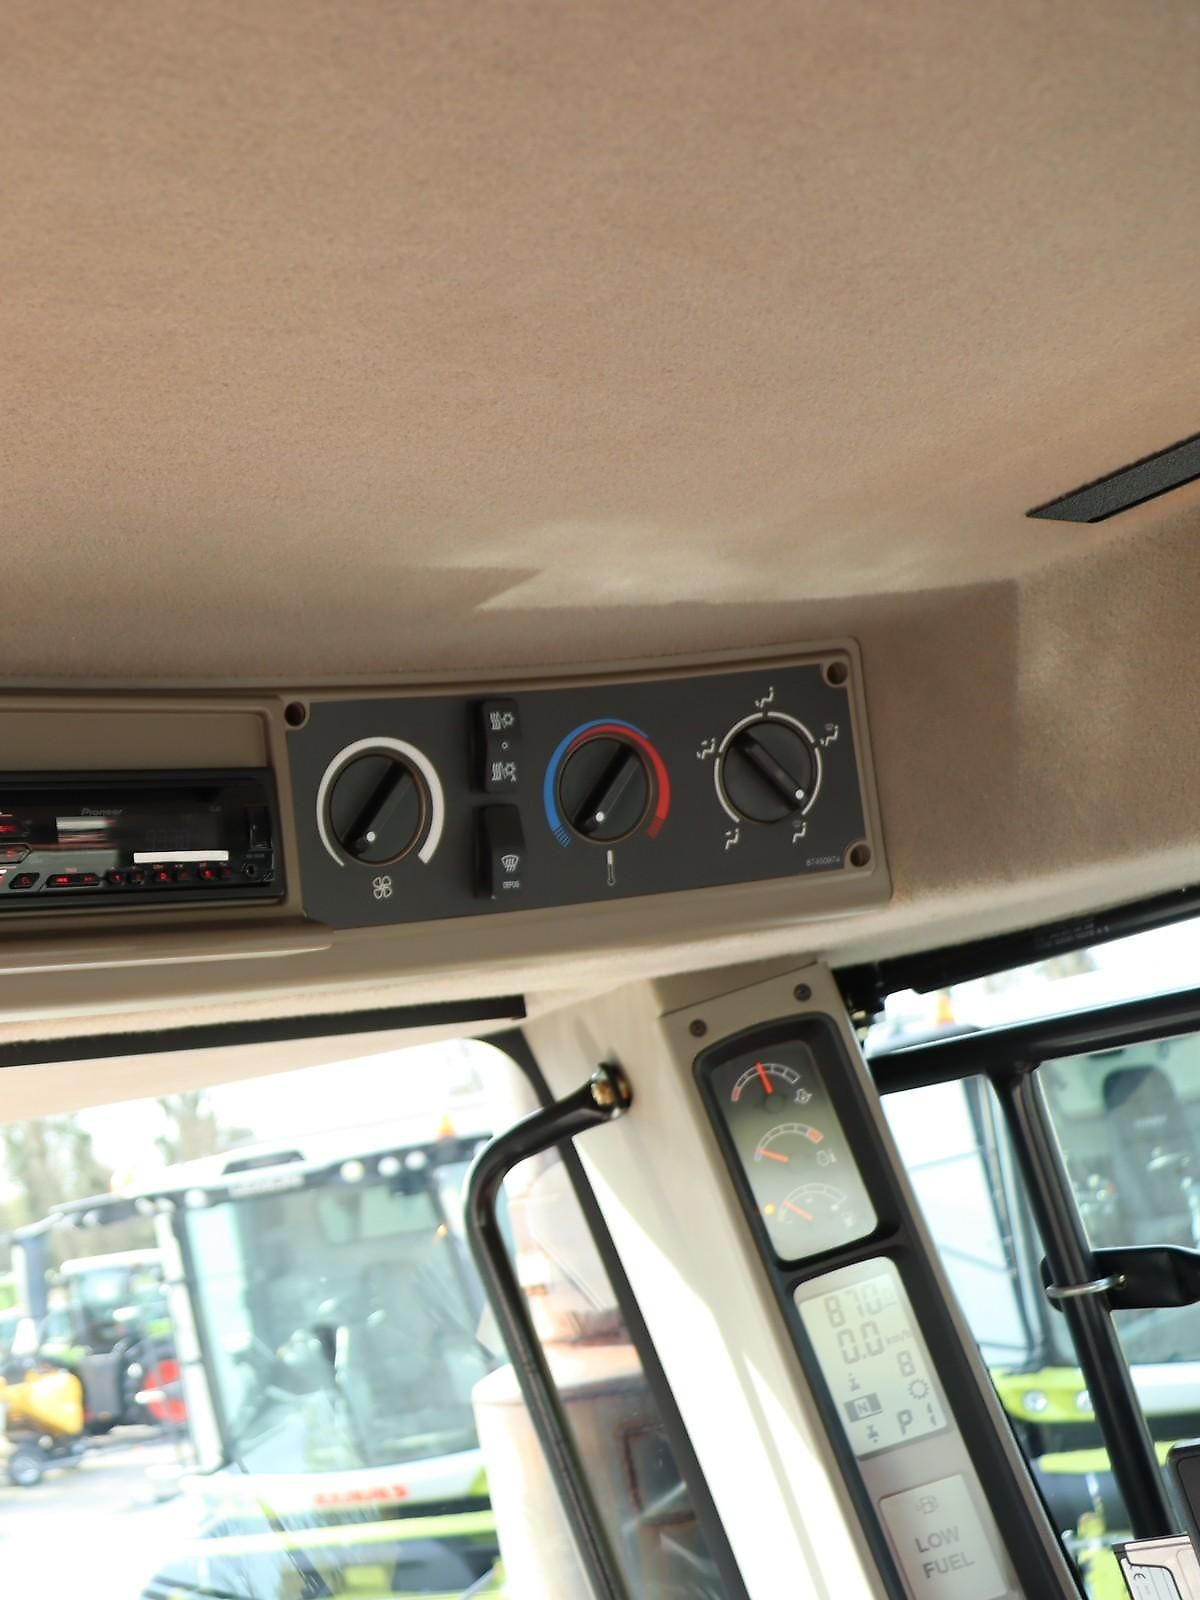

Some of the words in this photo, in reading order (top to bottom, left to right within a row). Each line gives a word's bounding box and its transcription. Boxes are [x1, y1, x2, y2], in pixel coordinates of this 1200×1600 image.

[837, 1320, 885, 1365] 0.0
[897, 1409, 913, 1435] P
[915, 1526, 960, 1553] LOW
[922, 1552, 976, 1579] FUEL
